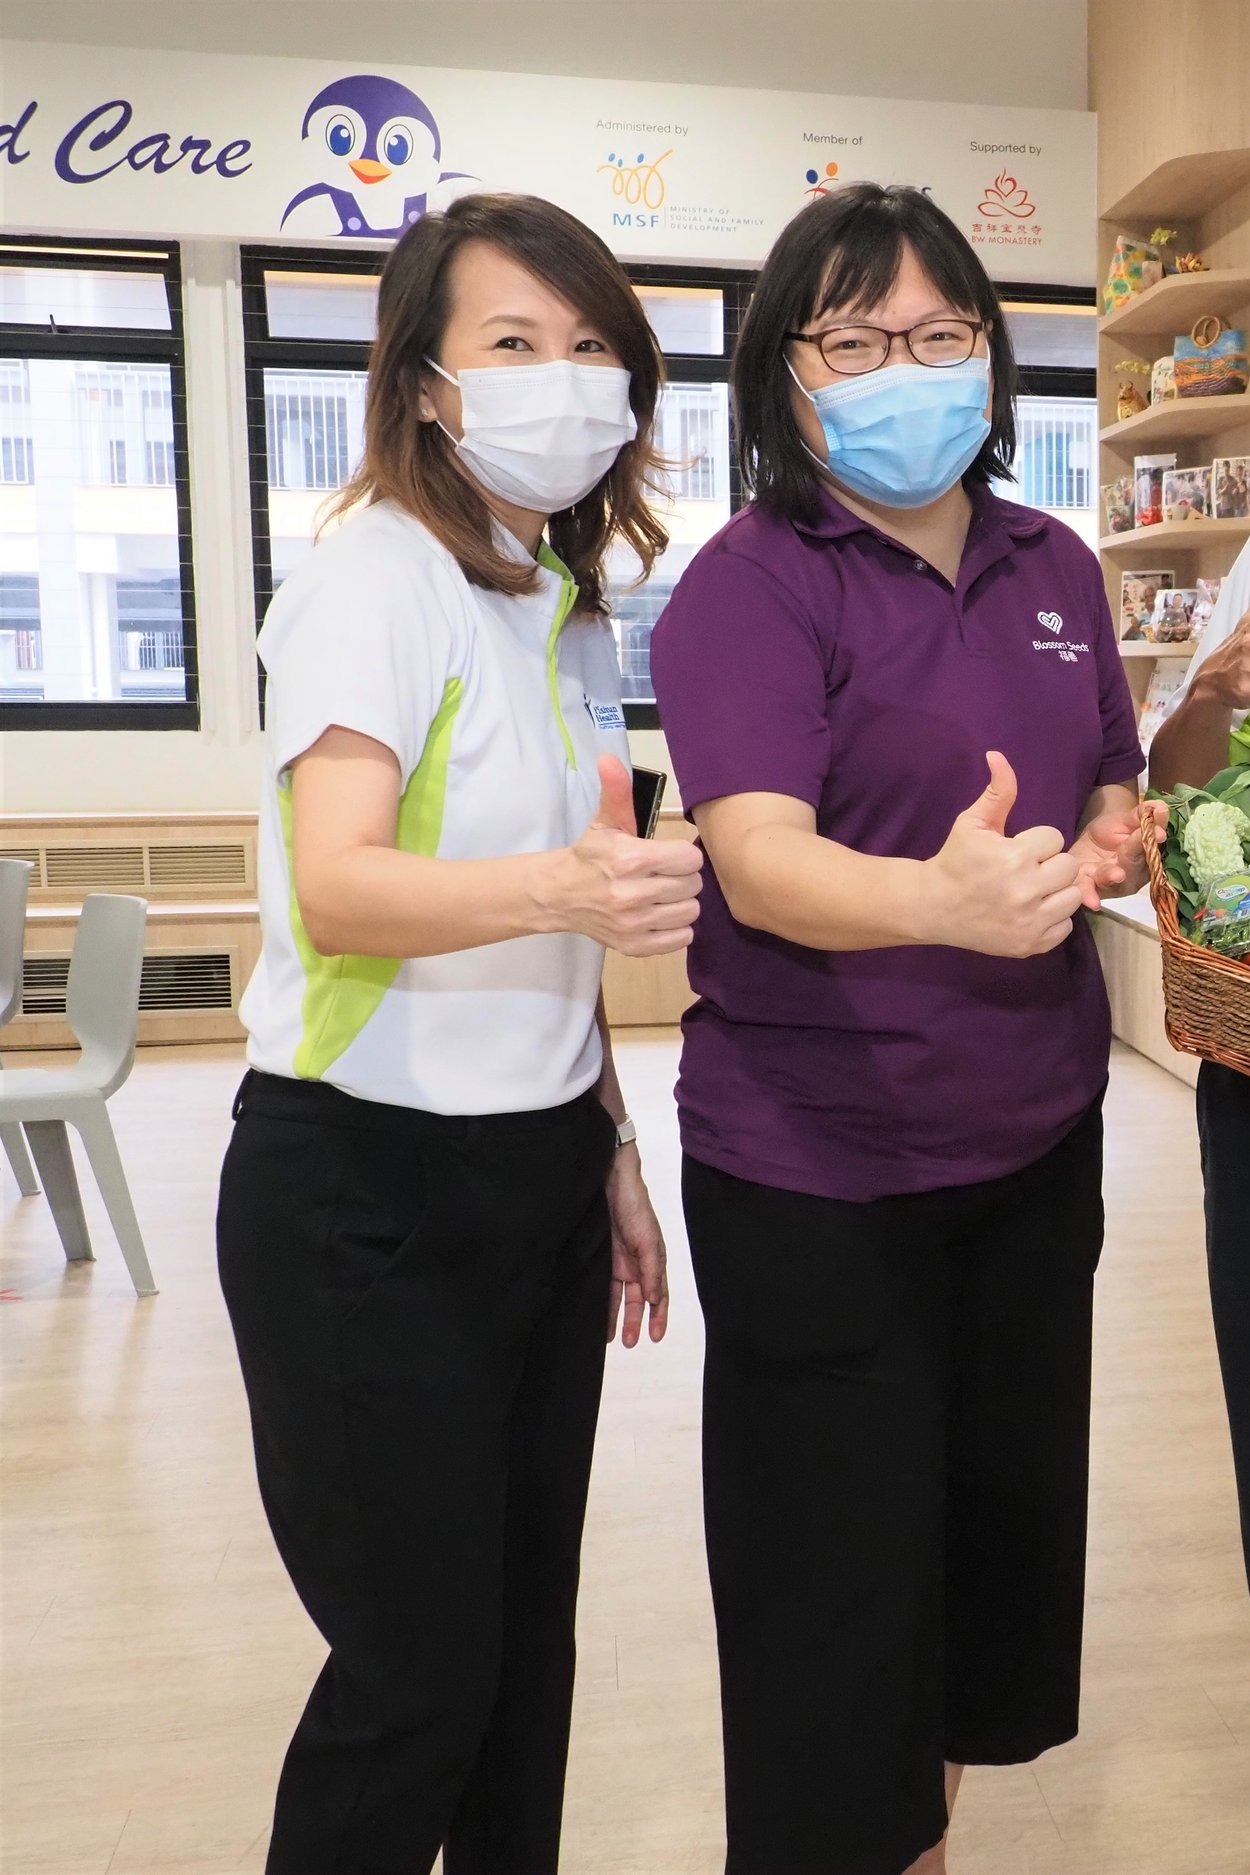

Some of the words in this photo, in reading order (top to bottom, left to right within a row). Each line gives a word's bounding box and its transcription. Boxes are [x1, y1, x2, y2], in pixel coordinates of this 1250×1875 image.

[596, 119, 671, 134] Administered
[674, 124, 689, 136] by
[54, 99, 253, 184] Care
[803, 132, 848, 145] Member
[851, 135, 863, 145] of
[970, 141, 1026, 154] Supported
[1029, 144, 1042, 156] by
[669, 206, 714, 214] MINISTRY
[612, 212, 660, 228] MSF
[669, 214, 703, 222] SOCIAL
[707, 216, 727, 224] AND
[731, 217, 764, 226] FAMILY
[670, 223, 737, 232] DEVELOPMENT
[971, 235, 986, 244] BW
[988, 236, 1043, 246] MONASTERY
[1032, 640, 1068, 651] Blossom
[1066, 641, 1089, 652] Seeds
